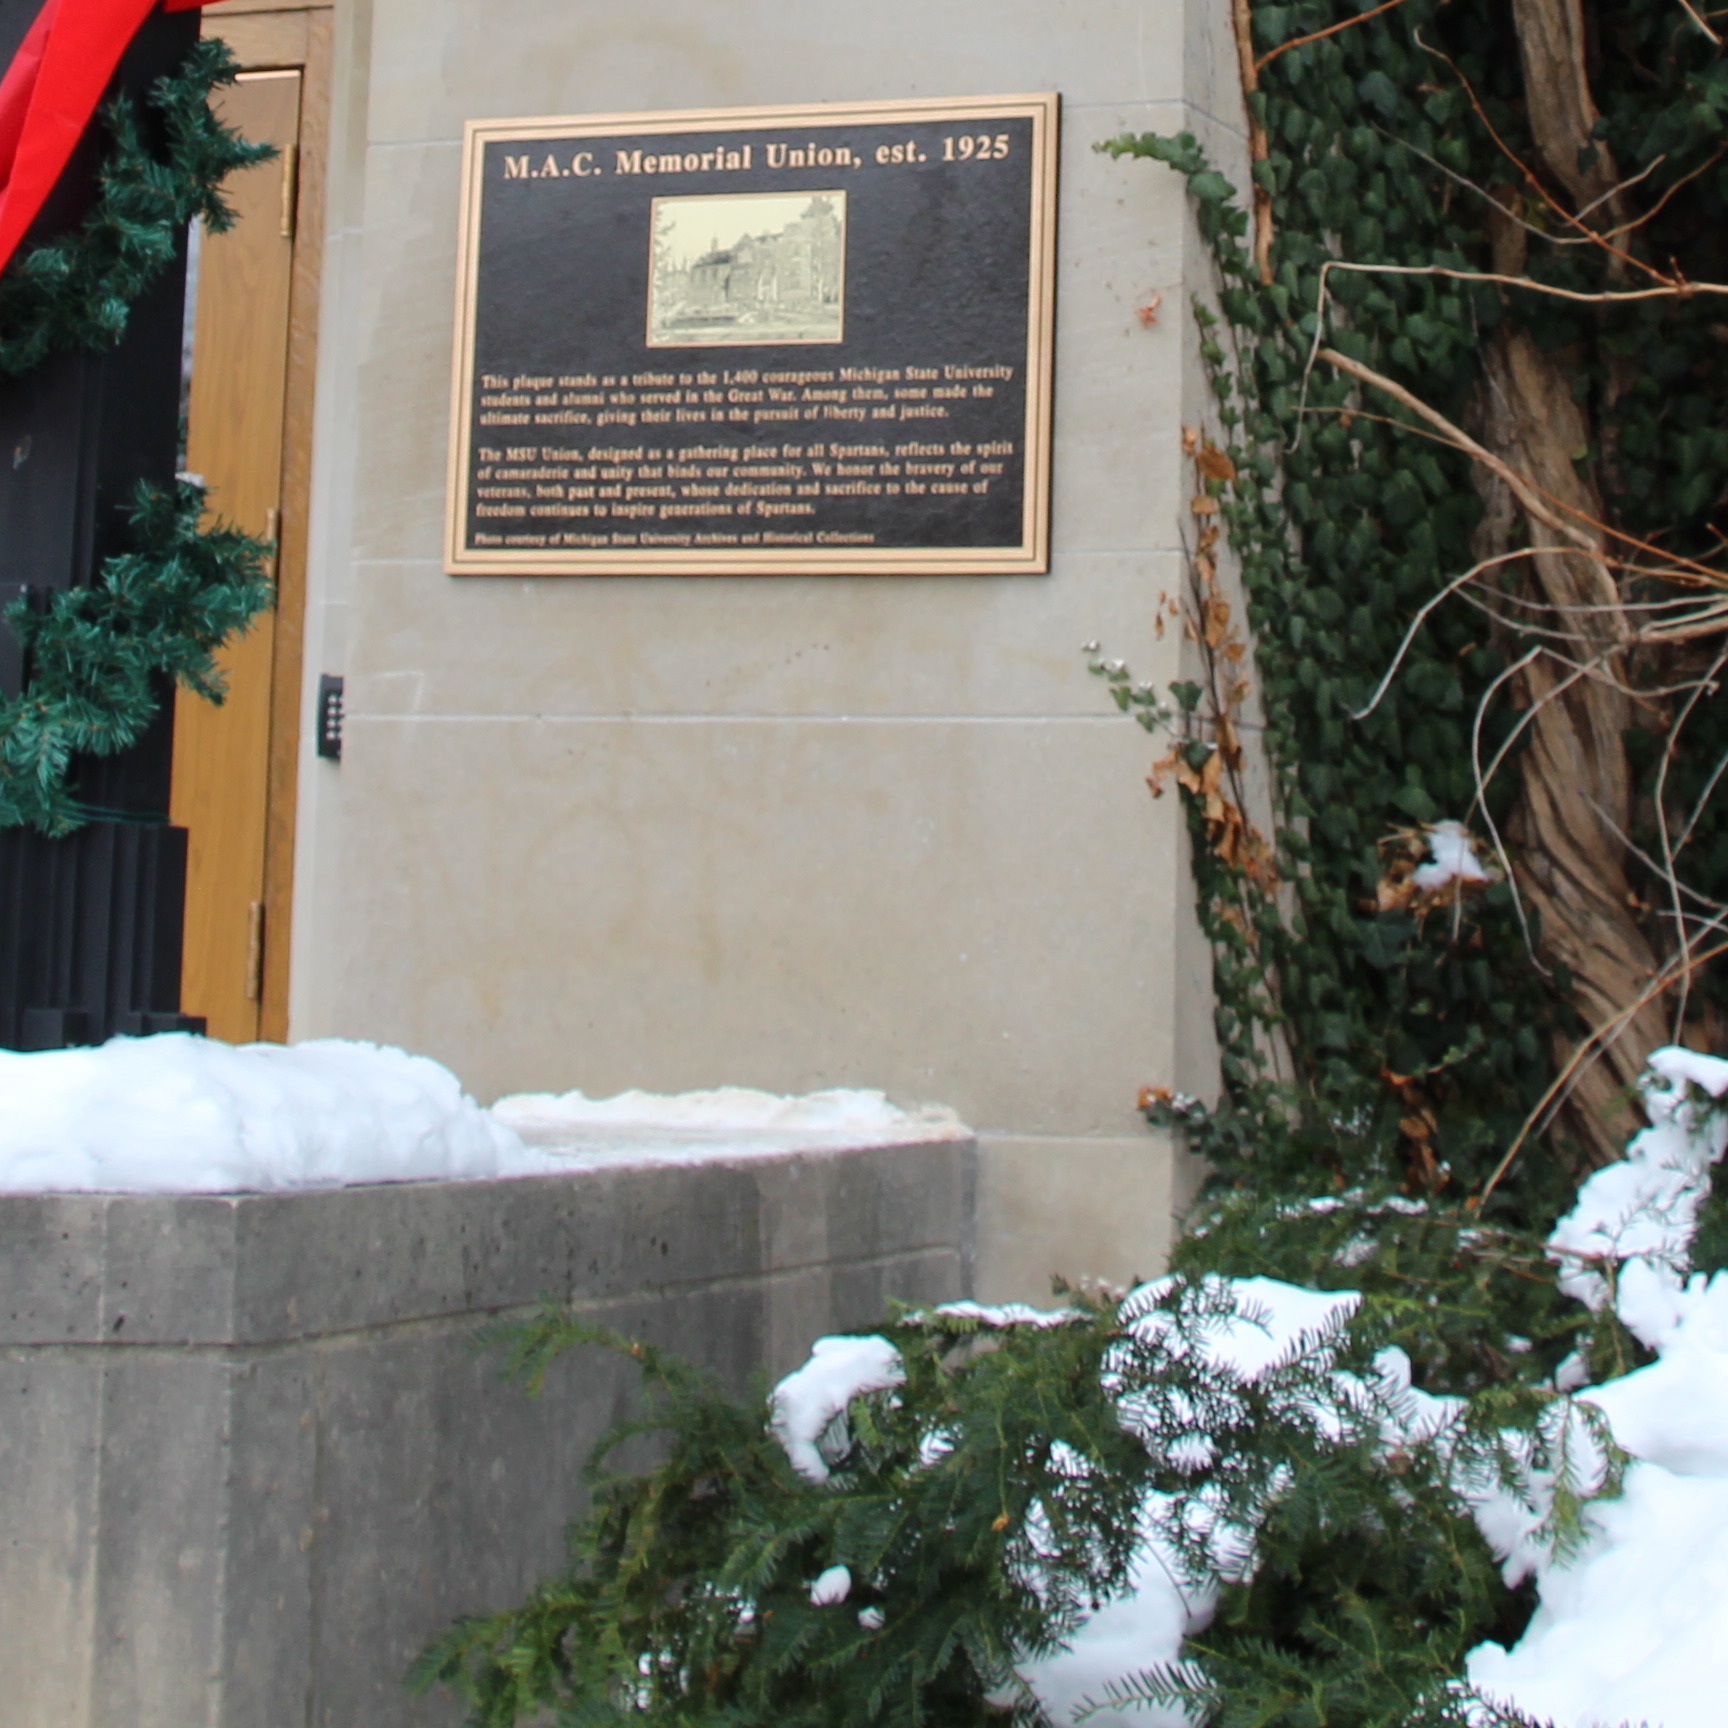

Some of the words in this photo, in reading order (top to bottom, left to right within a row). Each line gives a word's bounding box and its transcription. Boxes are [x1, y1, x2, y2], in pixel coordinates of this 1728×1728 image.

[504, 152, 602, 179] M.A.C.
[615, 144, 752, 175] Memorial
[765, 142, 862, 169] Union,
[875, 140, 927, 164] est.
[942, 134, 1010, 162] 1925
[481, 374, 510, 390] This
[512, 374, 555, 392] plaque
[558, 373, 598, 388] stands
[601, 376, 616, 387] as
[619, 375, 629, 387] a
[632, 372, 675, 387] tribute
[678, 373, 694, 386] to
[696, 370, 718, 386] the
[723, 369, 759, 385] 1,400
[761, 371, 835, 386] courageous
[839, 367, 901, 384] Michigan
[905, 365, 939, 381] State
[944, 364, 1014, 381] University
[480, 392, 532, 408] students
[534, 392, 559, 407] and
[561, 392, 605, 406] alumni
[609, 391, 636, 405] who
[639, 389, 682, 405] served
[685, 389, 700, 404] in
[702, 389, 724, 404] the
[727, 388, 764, 403] Great
[801, 388, 848, 404] Among
[893, 388, 928, 399] some
[932, 384, 968, 399] made
[972, 383, 994, 398] the
[479, 411, 531, 426] ultimate
[596, 409, 637, 427] giving
[640, 408, 672, 423] their
[675, 408, 707, 423] lives
[710, 408, 725, 422] in
[728, 407, 750, 422] the
[753, 406, 800, 425] pursuit
[803, 405, 820, 420] of
[823, 405, 867, 422] liberty
[871, 404, 896, 419] and
[478, 447, 502, 462] The
[505, 447, 538, 462] MSU
[587, 446, 644, 464] designed
[647, 448, 662, 461] as
[665, 448, 675, 460] a
[678, 444, 739, 463] gathering
[742, 445, 779, 462] place
[782, 443, 803, 458] for
[806, 443, 825, 458] all
[894, 441, 946, 457] reflects
[949, 441, 972, 456] the
[976, 440, 1014, 459] spirit
[476, 466, 492, 480] of
[494, 466, 570, 480] camaraderie
[573, 465, 598, 480] and
[600, 465, 634, 483] unity
[637, 464, 663, 479] that
[667, 464, 703, 479] binds
[705, 466, 729, 478] our
[811, 462, 832, 477] We
[836, 462, 875, 477] honor
[879, 461, 901, 476] the
[905, 461, 956, 478] bravery
[959, 459, 977, 475] of
[979, 462, 1004, 475] our
[535, 484, 565, 499] both
[567, 485, 595, 501] past
[598, 483, 622, 499] and
[680, 483, 721, 497] whose
[724, 482, 793, 497] dedication
[796, 481, 821, 496] and
[824, 480, 882, 496] sacrifice
[885, 482, 901, 495] to
[904, 479, 927, 495] the
[930, 482, 969, 495] cause
[972, 478, 989, 494] of
[475, 503, 527, 518] freedom
[529, 503, 590, 518] continues
[593, 504, 608, 518] to
[610, 502, 656, 520] inspire
[658, 502, 733, 520] generations
[736, 500, 753, 516] of
